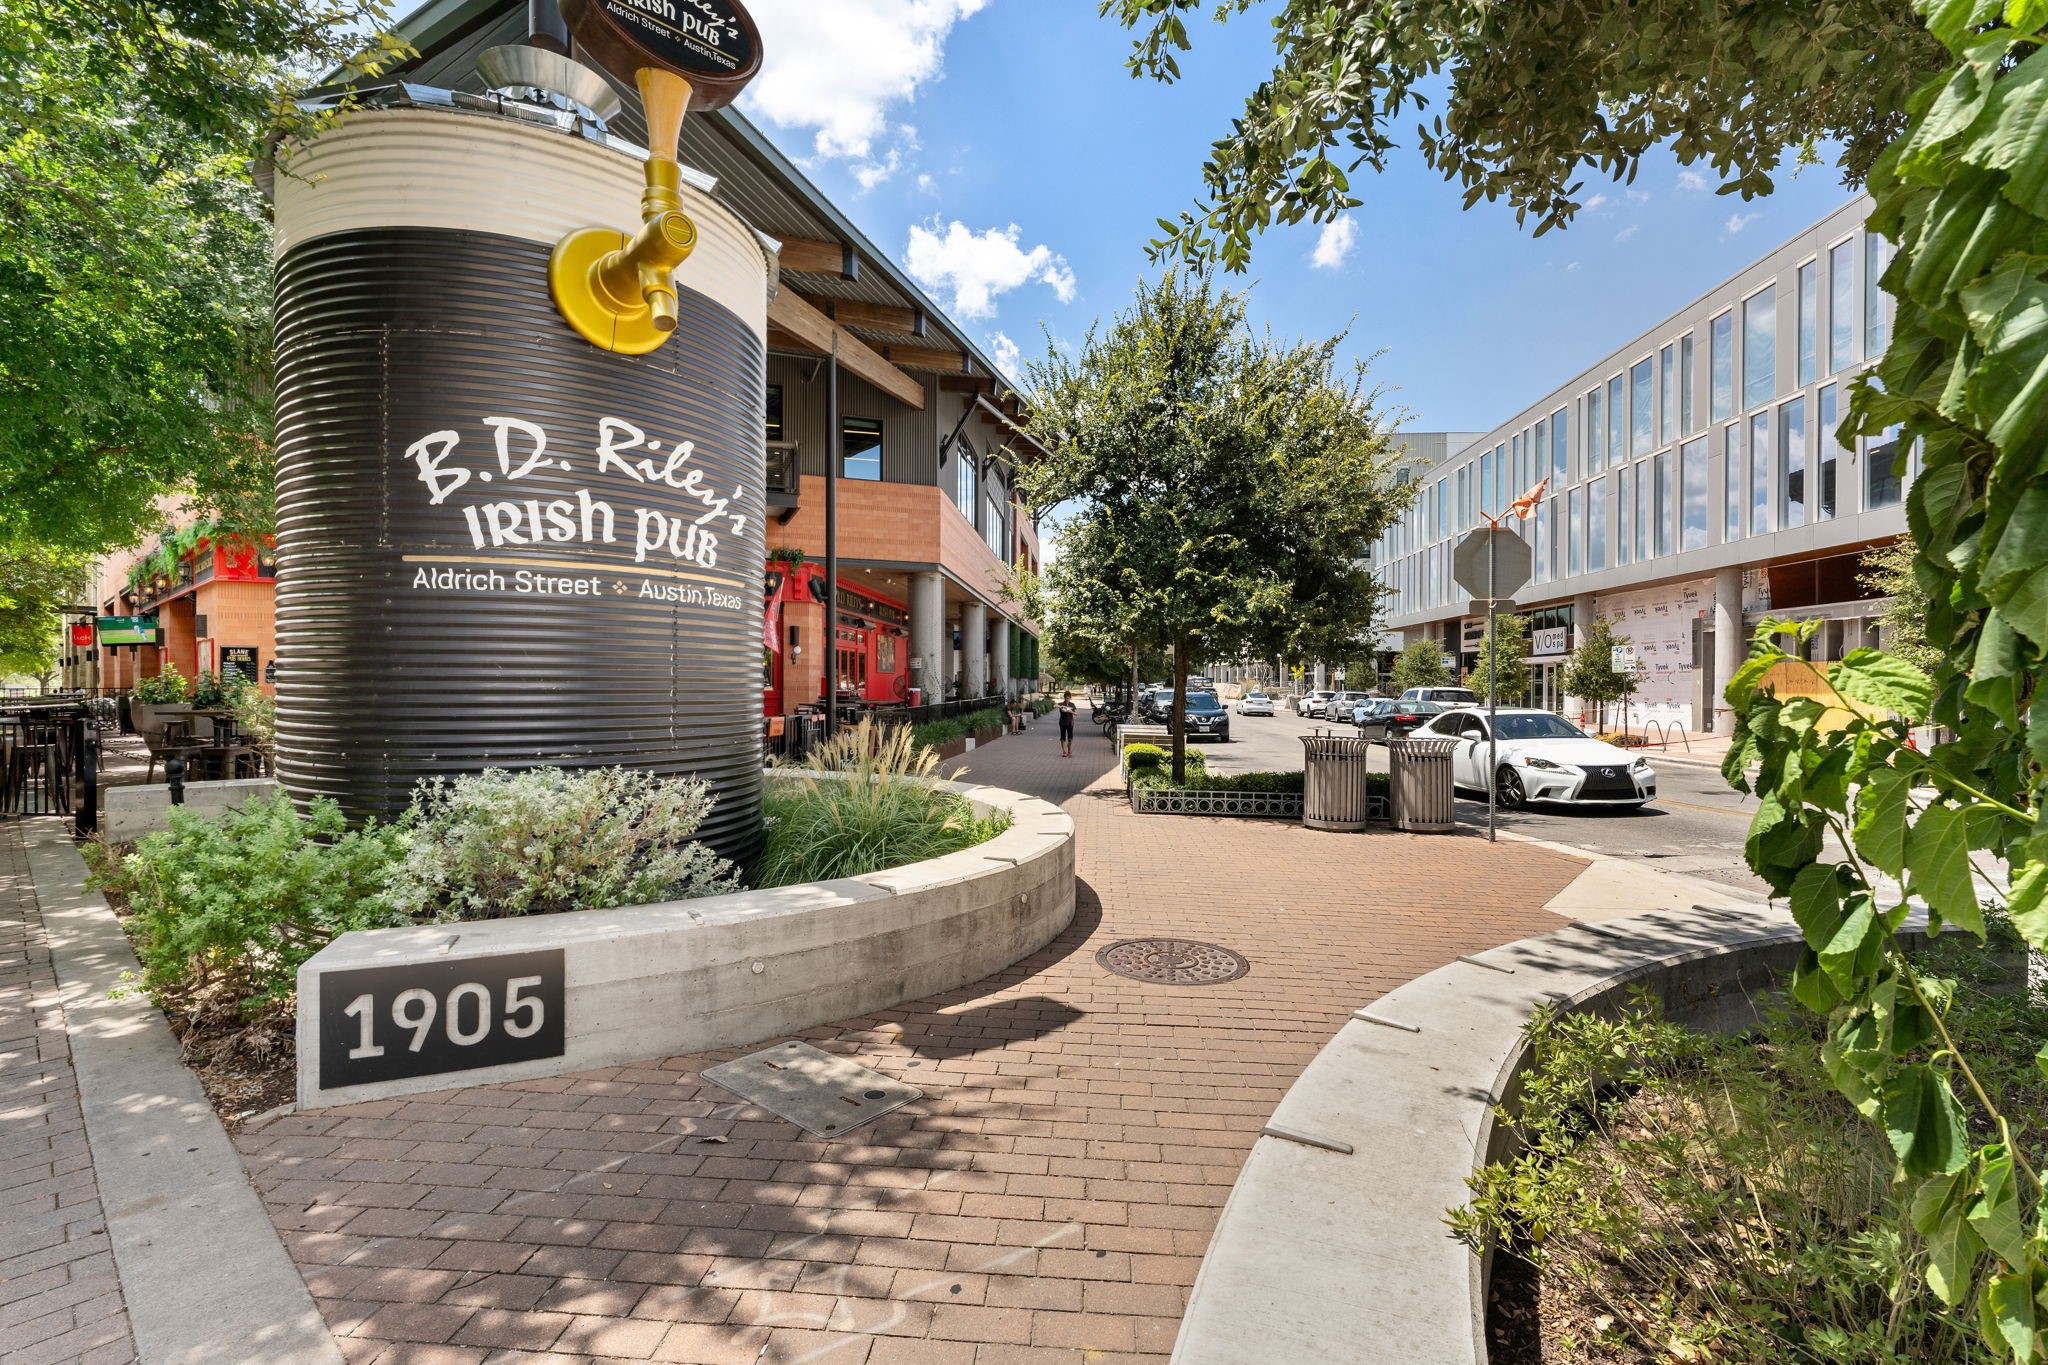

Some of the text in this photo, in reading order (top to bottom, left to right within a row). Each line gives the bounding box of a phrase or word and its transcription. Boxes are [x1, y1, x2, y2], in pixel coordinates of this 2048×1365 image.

[607, 1, 639, 24] Aldrich
[641, 18, 671, 39] Street
[596, 417, 747, 536] Riley's
[413, 567, 505, 591] Aldrich
[515, 570, 602, 596] Street
[1683, 591, 1698, 600] Tyvek
[1552, 631, 1564, 640] med
[1552, 640, 1564, 649] spa
[1666, 702, 1680, 710] Tyvek
[344, 975, 545, 1060] 1905
